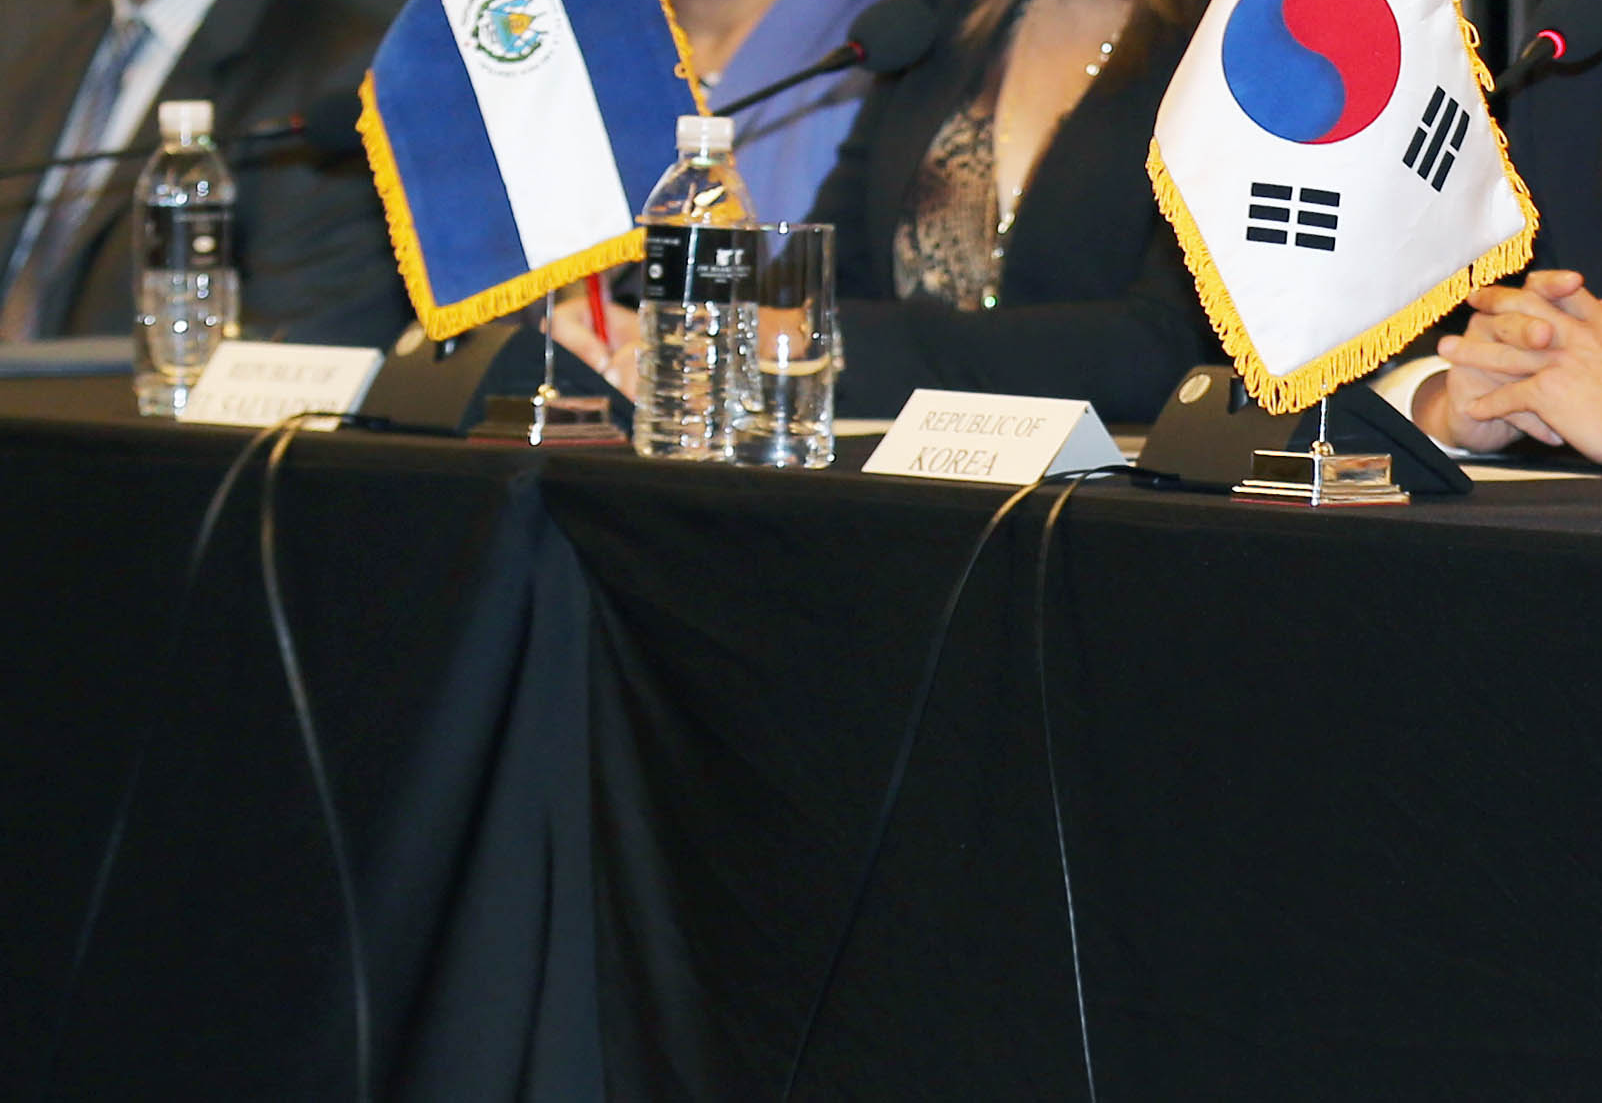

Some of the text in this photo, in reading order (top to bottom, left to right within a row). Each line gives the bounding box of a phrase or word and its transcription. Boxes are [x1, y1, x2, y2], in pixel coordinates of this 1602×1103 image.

[919, 410, 1049, 438] REPUBLIC OF
[908, 446, 1000, 476] KOREA
